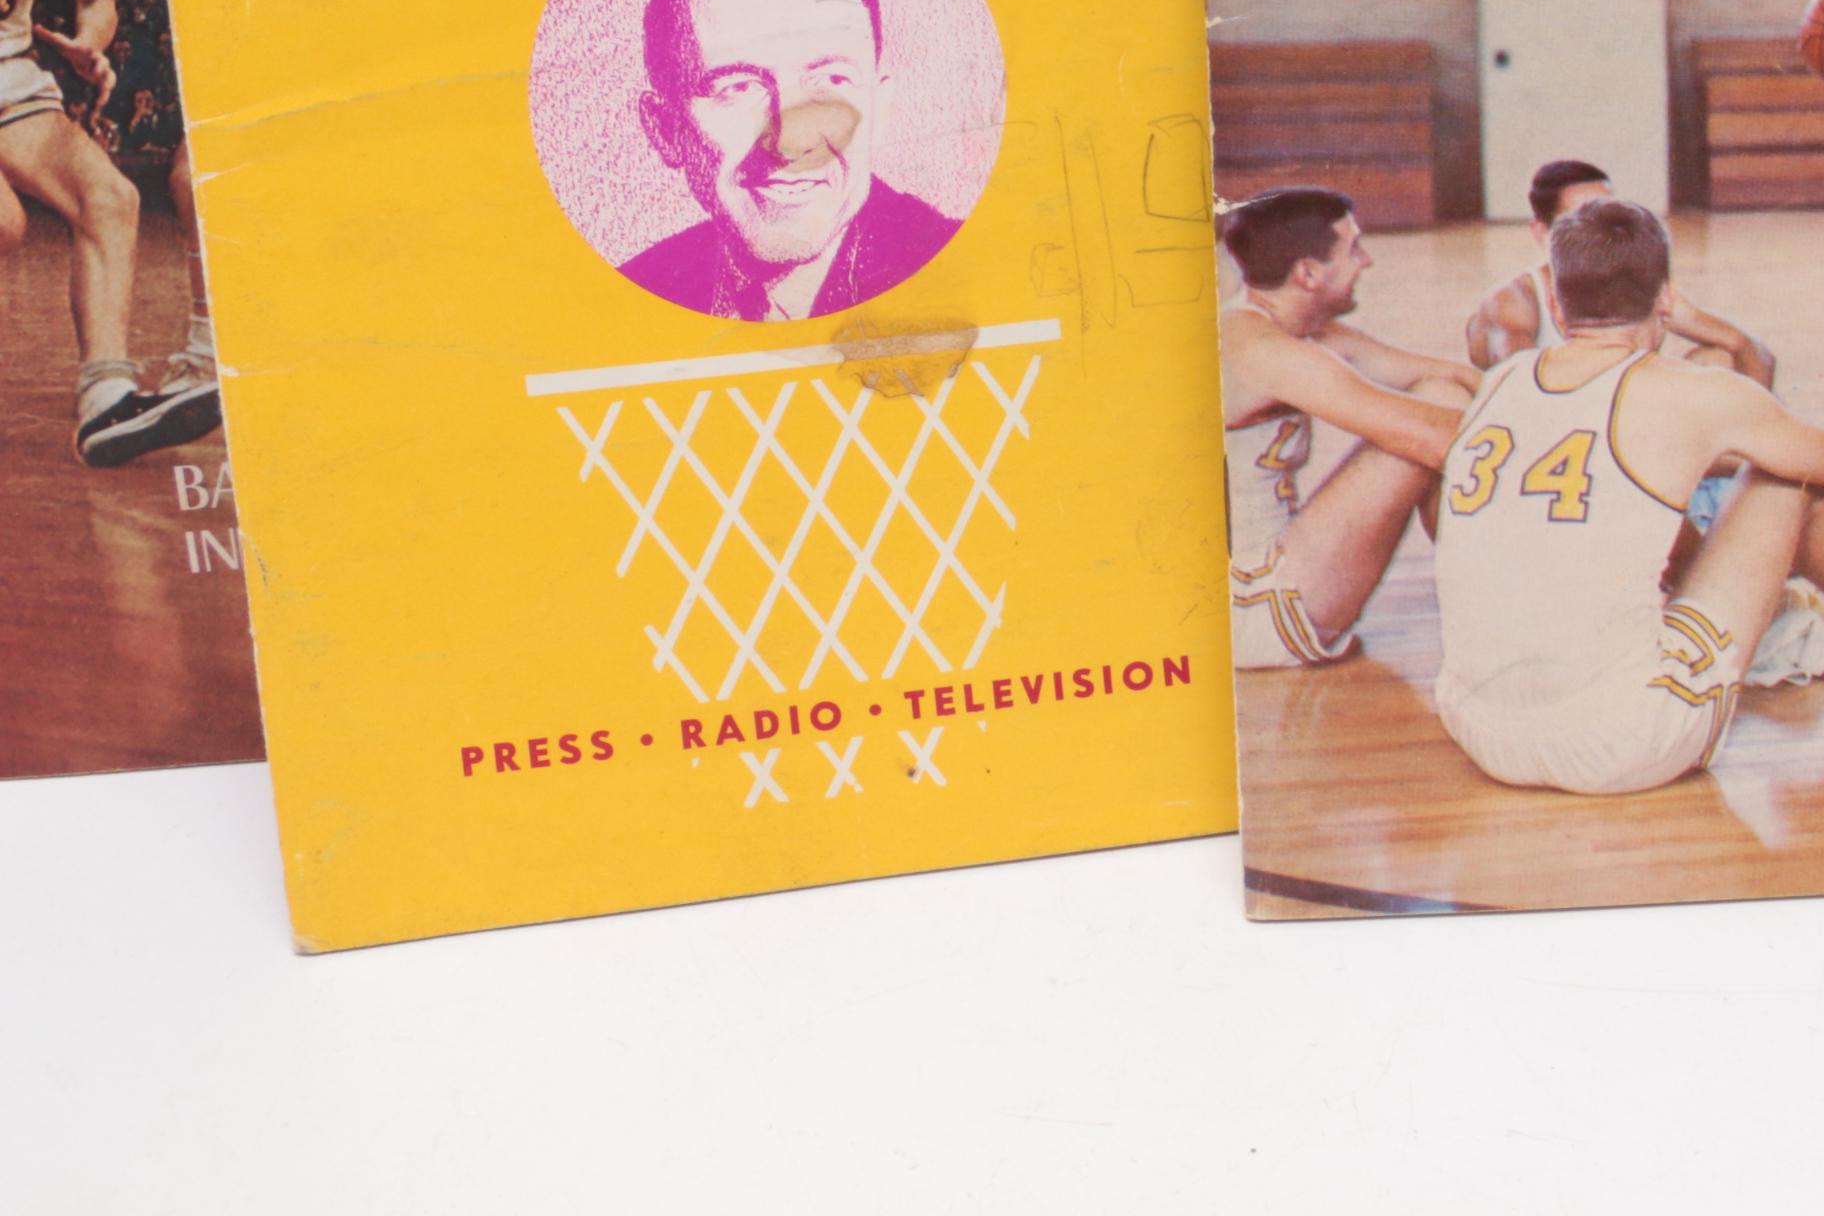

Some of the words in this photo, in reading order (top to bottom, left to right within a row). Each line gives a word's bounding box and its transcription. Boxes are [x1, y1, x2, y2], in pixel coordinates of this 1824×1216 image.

[1446, 423, 1598, 524] 34
[460, 728, 615, 777] PRESS
[679, 700, 843, 750] RADIO
[903, 654, 1194, 721] TELEVISION
